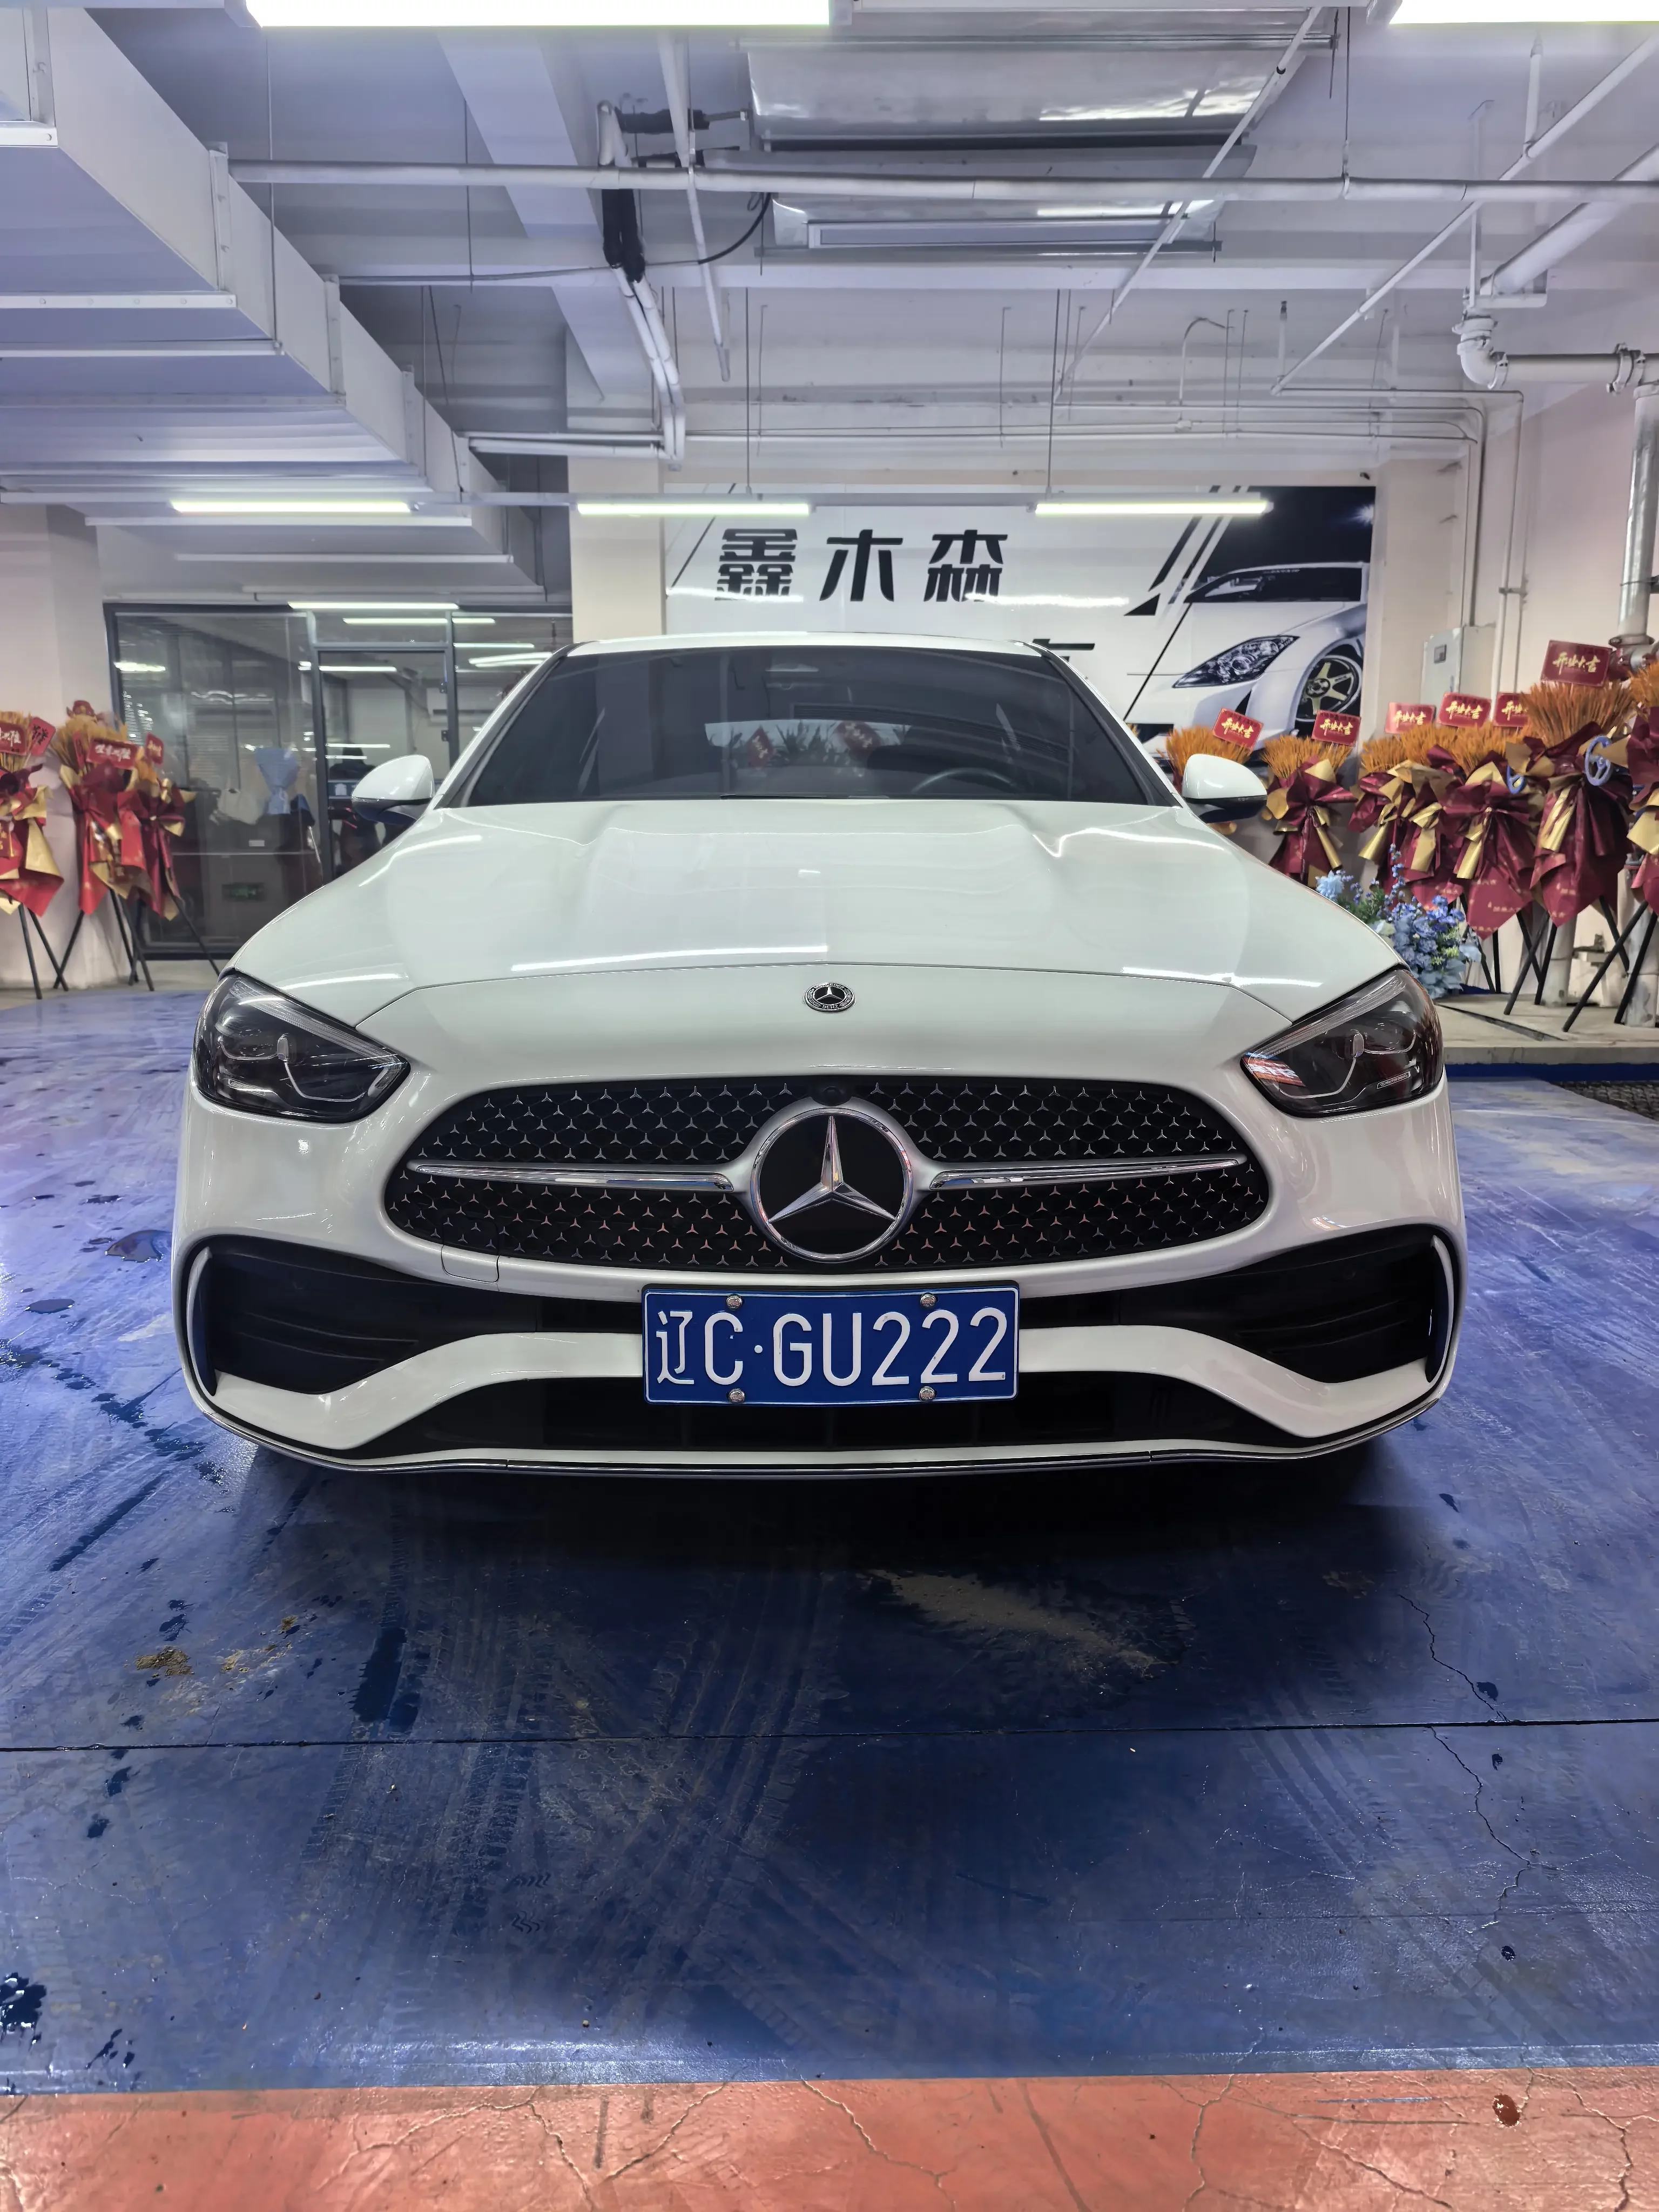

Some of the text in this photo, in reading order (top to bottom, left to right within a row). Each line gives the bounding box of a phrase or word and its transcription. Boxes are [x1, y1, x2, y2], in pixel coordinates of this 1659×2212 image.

[714, 528, 1008, 602] 鑫木森
[656, 1306, 1008, 1386] 辽C·GU222
